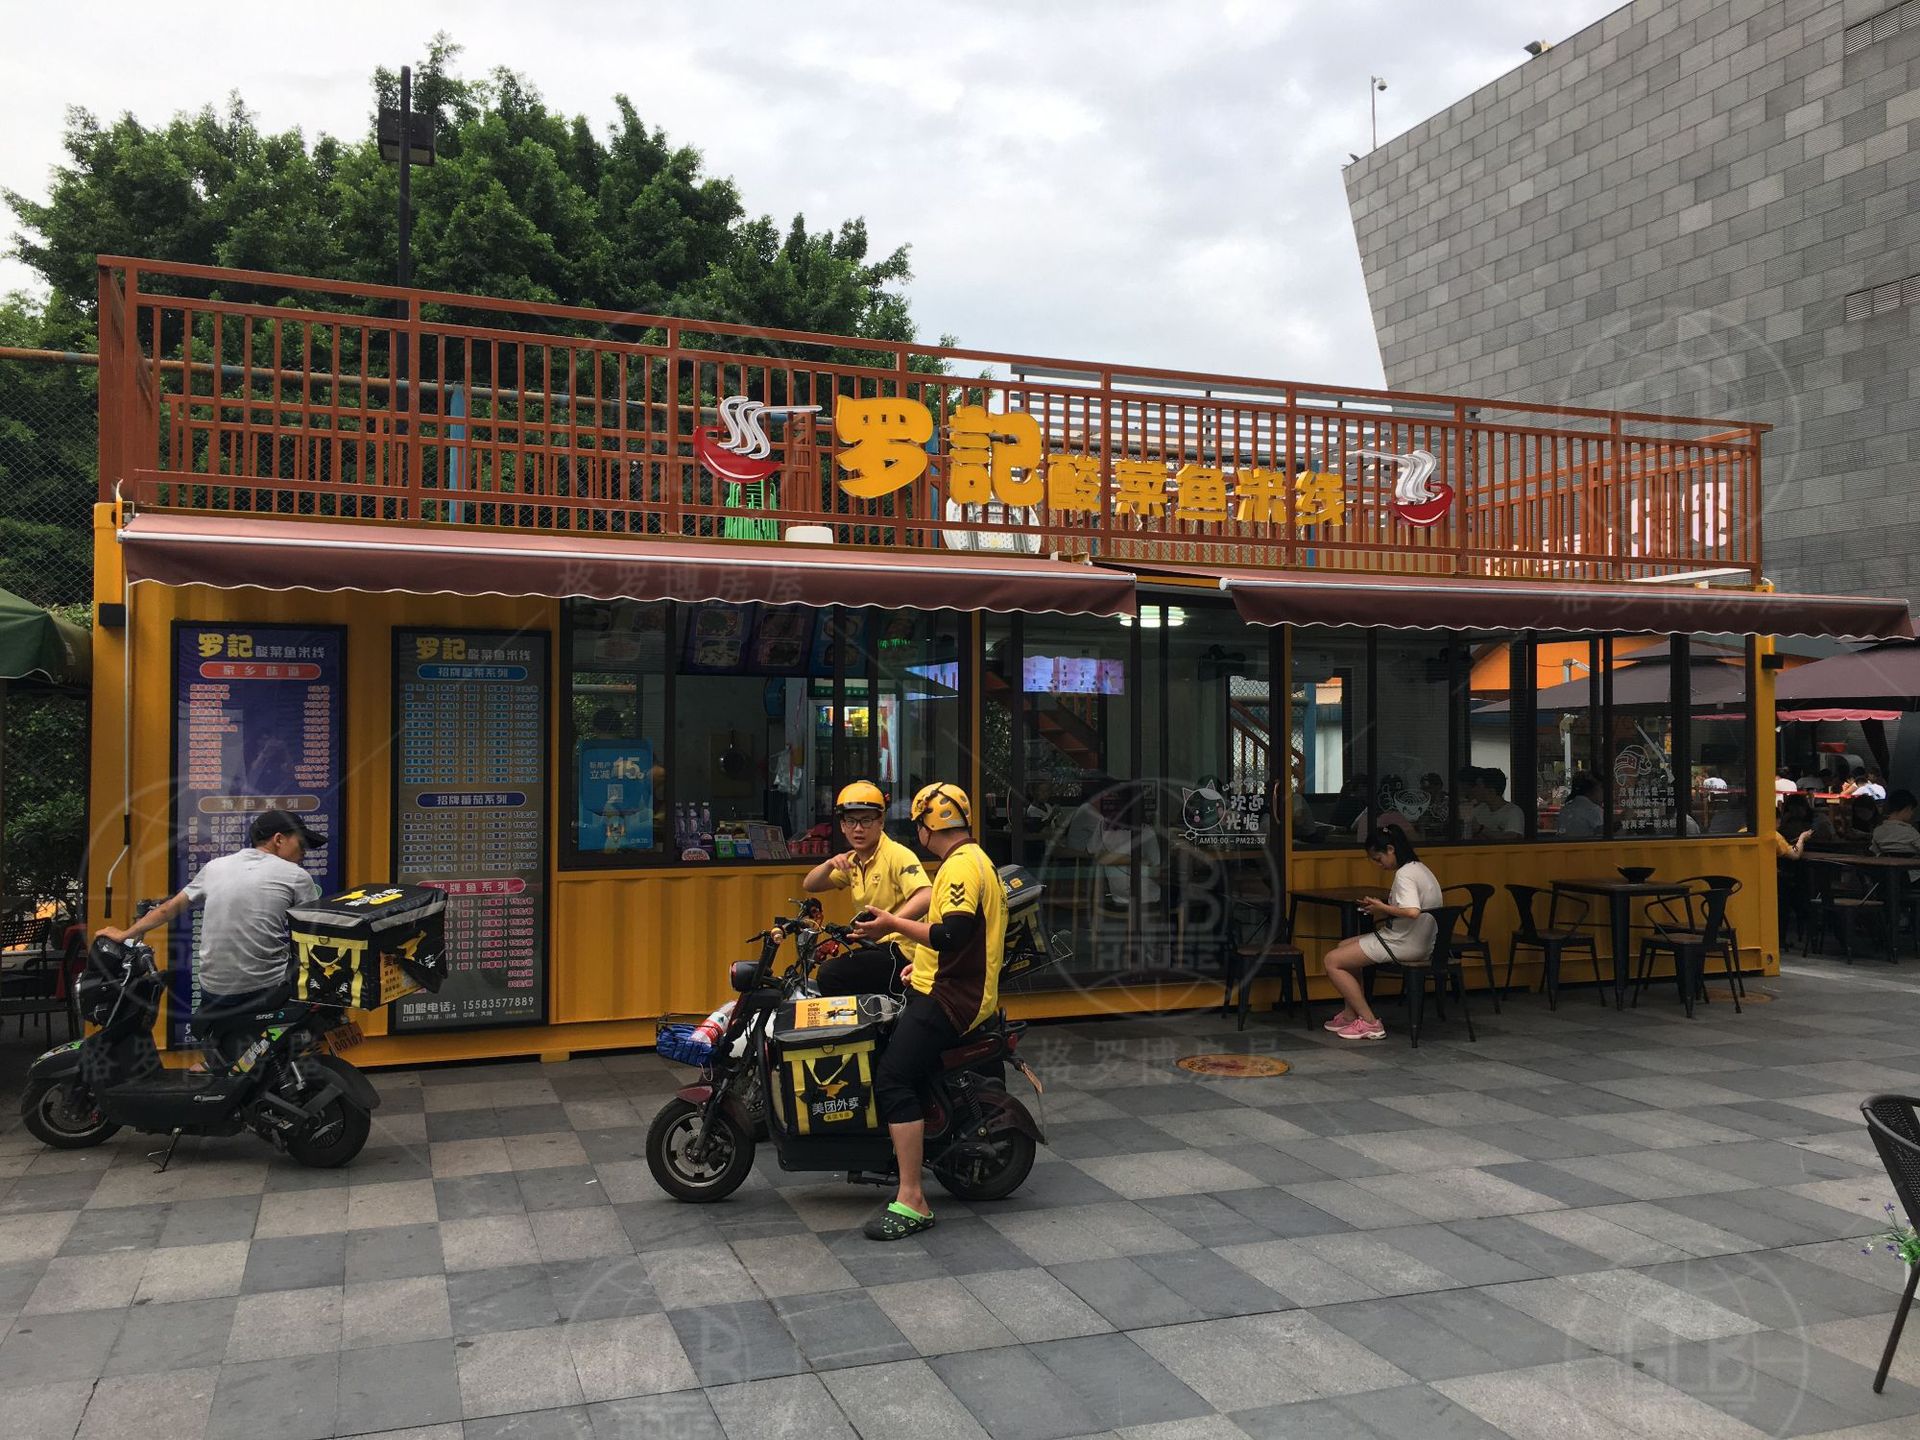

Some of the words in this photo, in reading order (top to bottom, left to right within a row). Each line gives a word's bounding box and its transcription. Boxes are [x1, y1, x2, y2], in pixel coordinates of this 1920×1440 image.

[1047, 453, 1346, 526] 酸菜鱼米线
[255, 645, 326, 659] 酸菜鱼米线
[468, 648, 531, 662] 酸菜鱼米线
[436, 794, 508, 806] 招牌番茄系列
[1230, 794, 1264, 812] 欢迎
[1226, 812, 1260, 831] 光临
[463, 996, 535, 1011] 15583577889
[810, 1095, 861, 1116] 美团外卖
